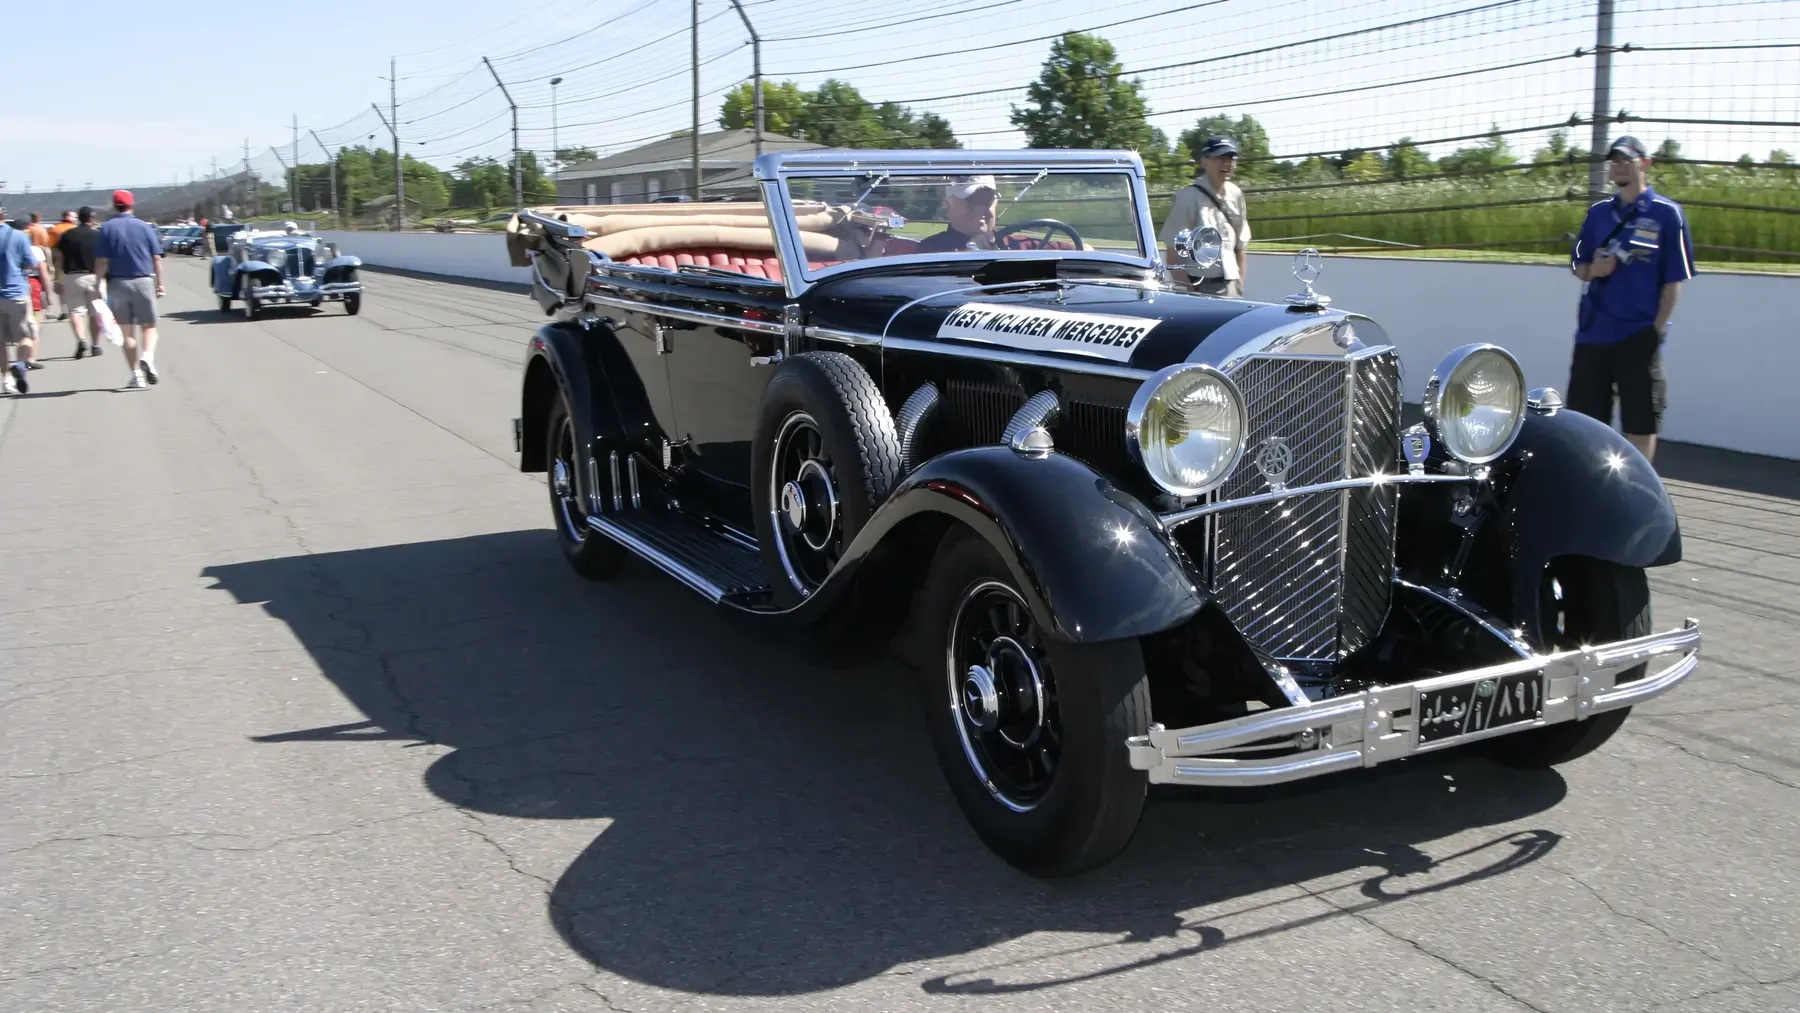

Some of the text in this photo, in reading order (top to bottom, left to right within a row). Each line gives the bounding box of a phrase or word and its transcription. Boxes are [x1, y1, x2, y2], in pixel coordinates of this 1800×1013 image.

[945, 308, 1146, 348] WEST MCLAREN MERCEDES
